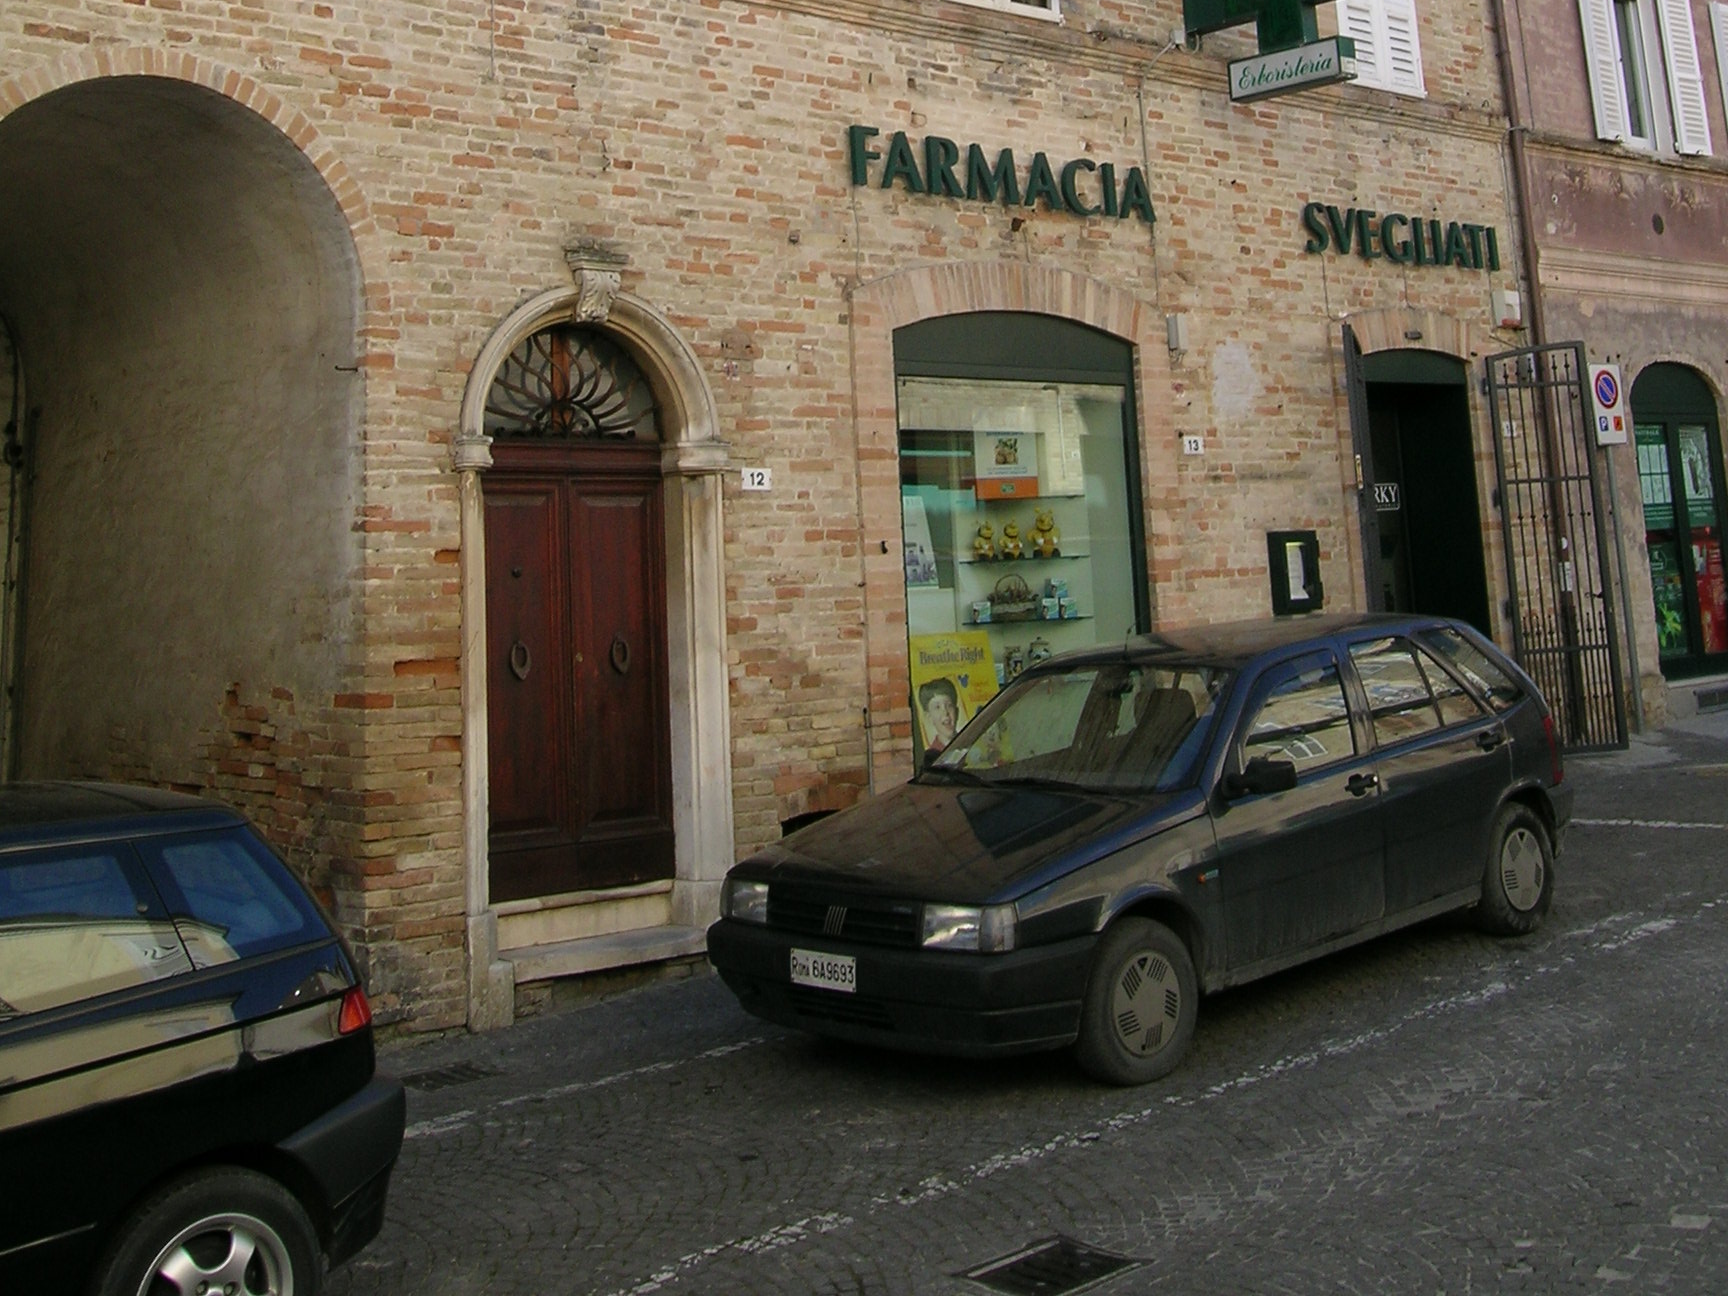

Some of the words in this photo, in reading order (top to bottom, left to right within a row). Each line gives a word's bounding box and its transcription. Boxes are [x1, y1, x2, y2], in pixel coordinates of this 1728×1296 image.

[1239, 54, 1331, 89] Erboristeria
[849, 124, 1157, 223] FARMACIA
[1304, 202, 1500, 271] SVEGLIATI
[1188, 439, 1199, 451] 13
[750, 472, 764, 486] 12
[812, 959, 854, 984] 6A9693
